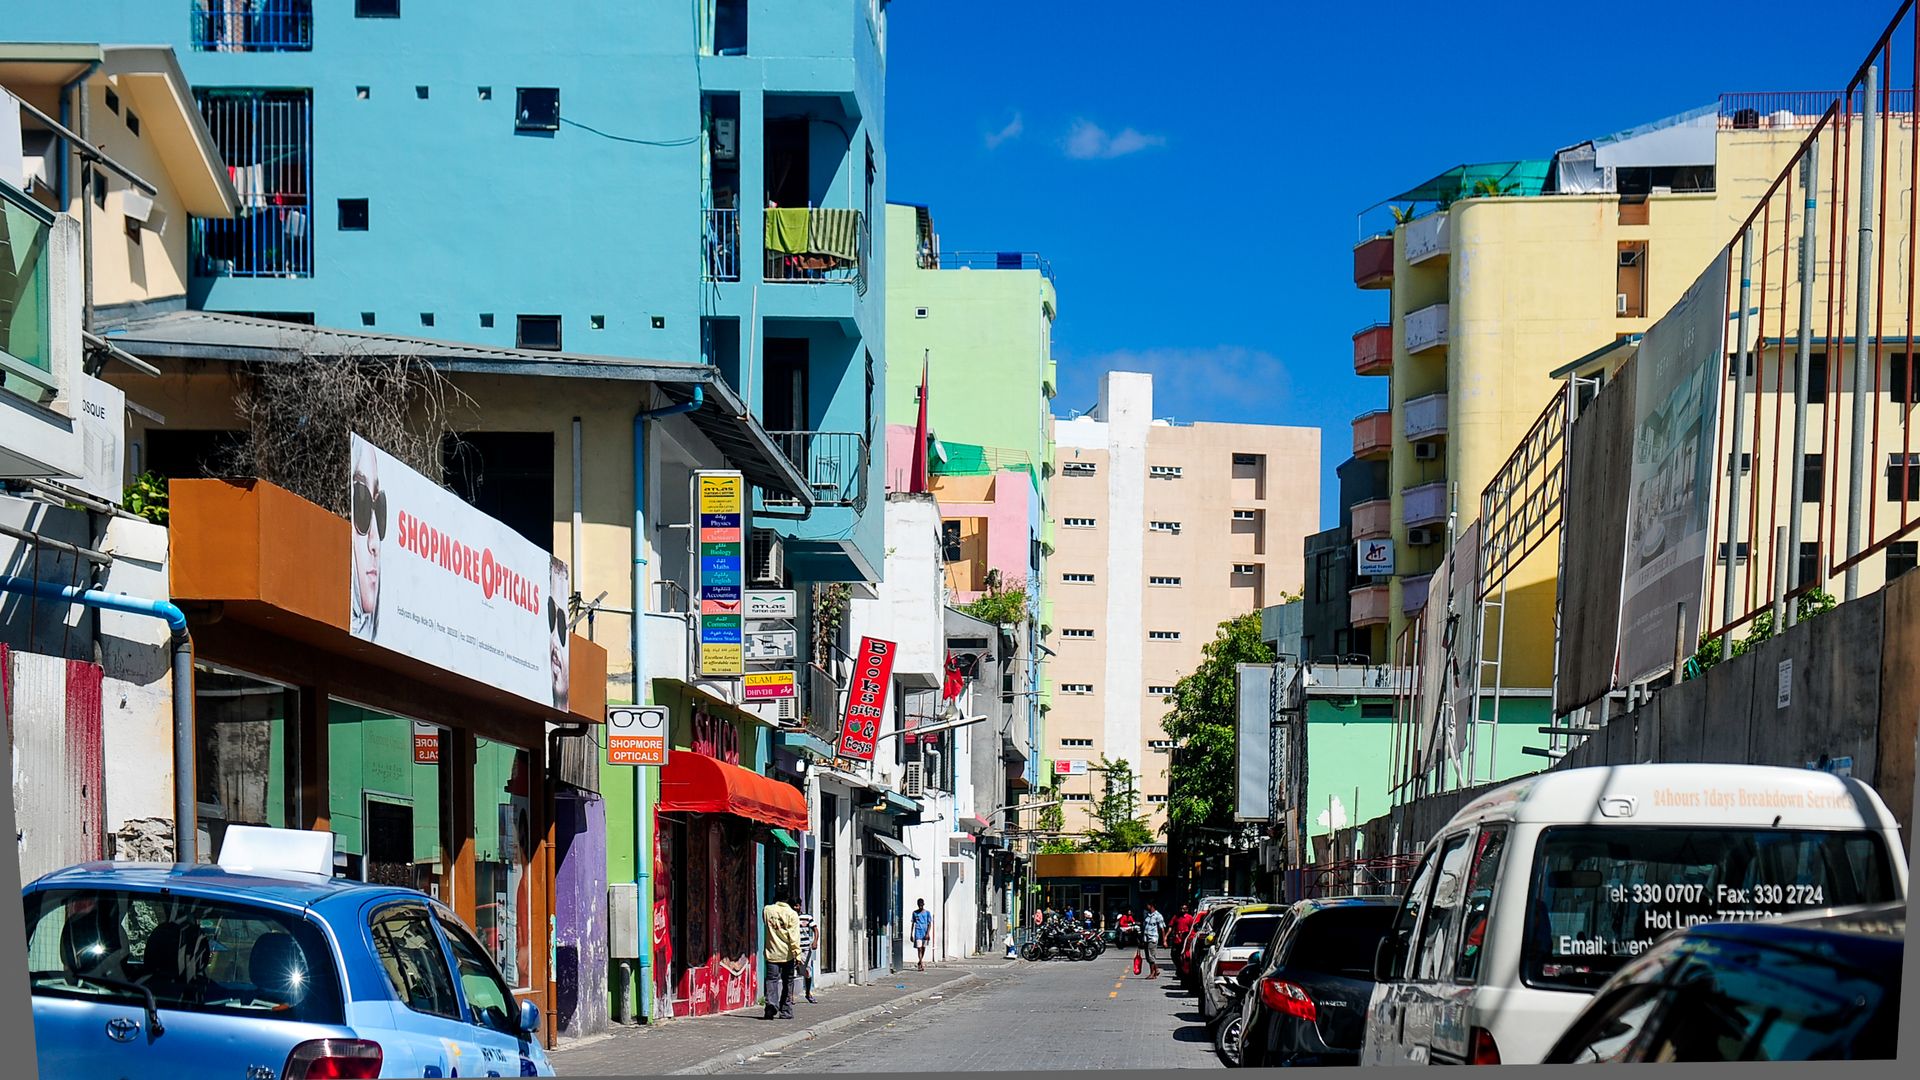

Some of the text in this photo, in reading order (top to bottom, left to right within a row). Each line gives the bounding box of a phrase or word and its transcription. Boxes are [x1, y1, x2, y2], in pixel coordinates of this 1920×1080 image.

[398, 509, 540, 616] SHOPMORE OPTICALS
[711, 577, 732, 585] English
[747, 676, 772, 684] ISLAM
[861, 639, 887, 704] Books
[747, 688, 773, 696] DHIVEHI
[850, 704, 880, 718] gift
[862, 720, 875, 740] &
[610, 739, 663, 749] SHOPMORE
[845, 736, 873, 754] toys
[613, 751, 659, 761] OPTICALS
[1738, 788, 1804, 808] Breakdown
[1605, 884, 1628, 903] Tel:
[1633, 885, 1662, 903] 330
[1665, 885, 1702, 903] 0707
[1717, 885, 1750, 904] Fax:
[1754, 885, 1783, 904] 330
[1786, 885, 1824, 904] 2724
[1645, 910, 1673, 929] Hot
[1560, 935, 1607, 956] Email:
